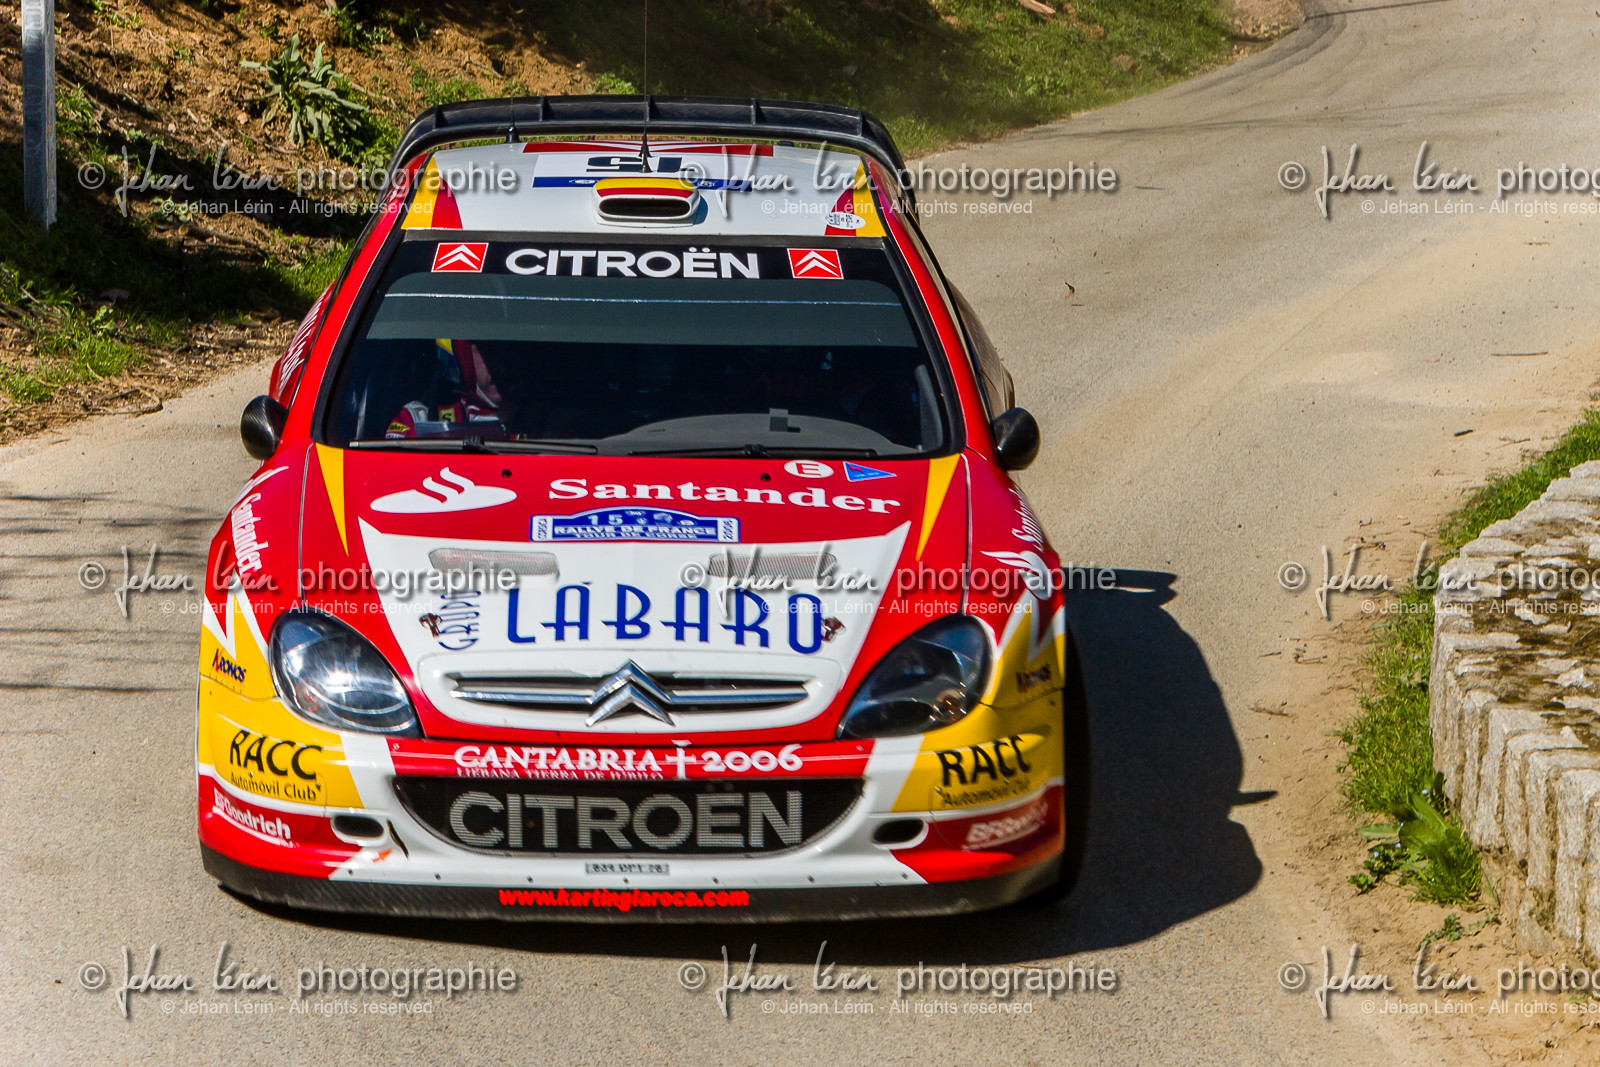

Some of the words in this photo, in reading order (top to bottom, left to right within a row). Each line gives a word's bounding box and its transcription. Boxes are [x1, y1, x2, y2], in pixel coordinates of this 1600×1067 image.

[506, 246, 760, 280] CITROËN
[549, 478, 901, 514] Santander
[554, 526, 617, 535] RALLYE
[622, 525, 646, 534] DE
[648, 526, 717, 535] FRANCE
[588, 514, 623, 525] 15
[438, 589, 481, 651] GRUPO
[212, 648, 246, 683] KRONOS
[230, 729, 323, 780] RACC
[453, 745, 663, 772] CANTABRIA
[701, 743, 804, 773] 2006
[935, 735, 1031, 787] RACC
[284, 783, 317, 801] Club
[449, 783, 803, 850] CITROËN
[498, 887, 750, 912] www.kartinglaroca.com
